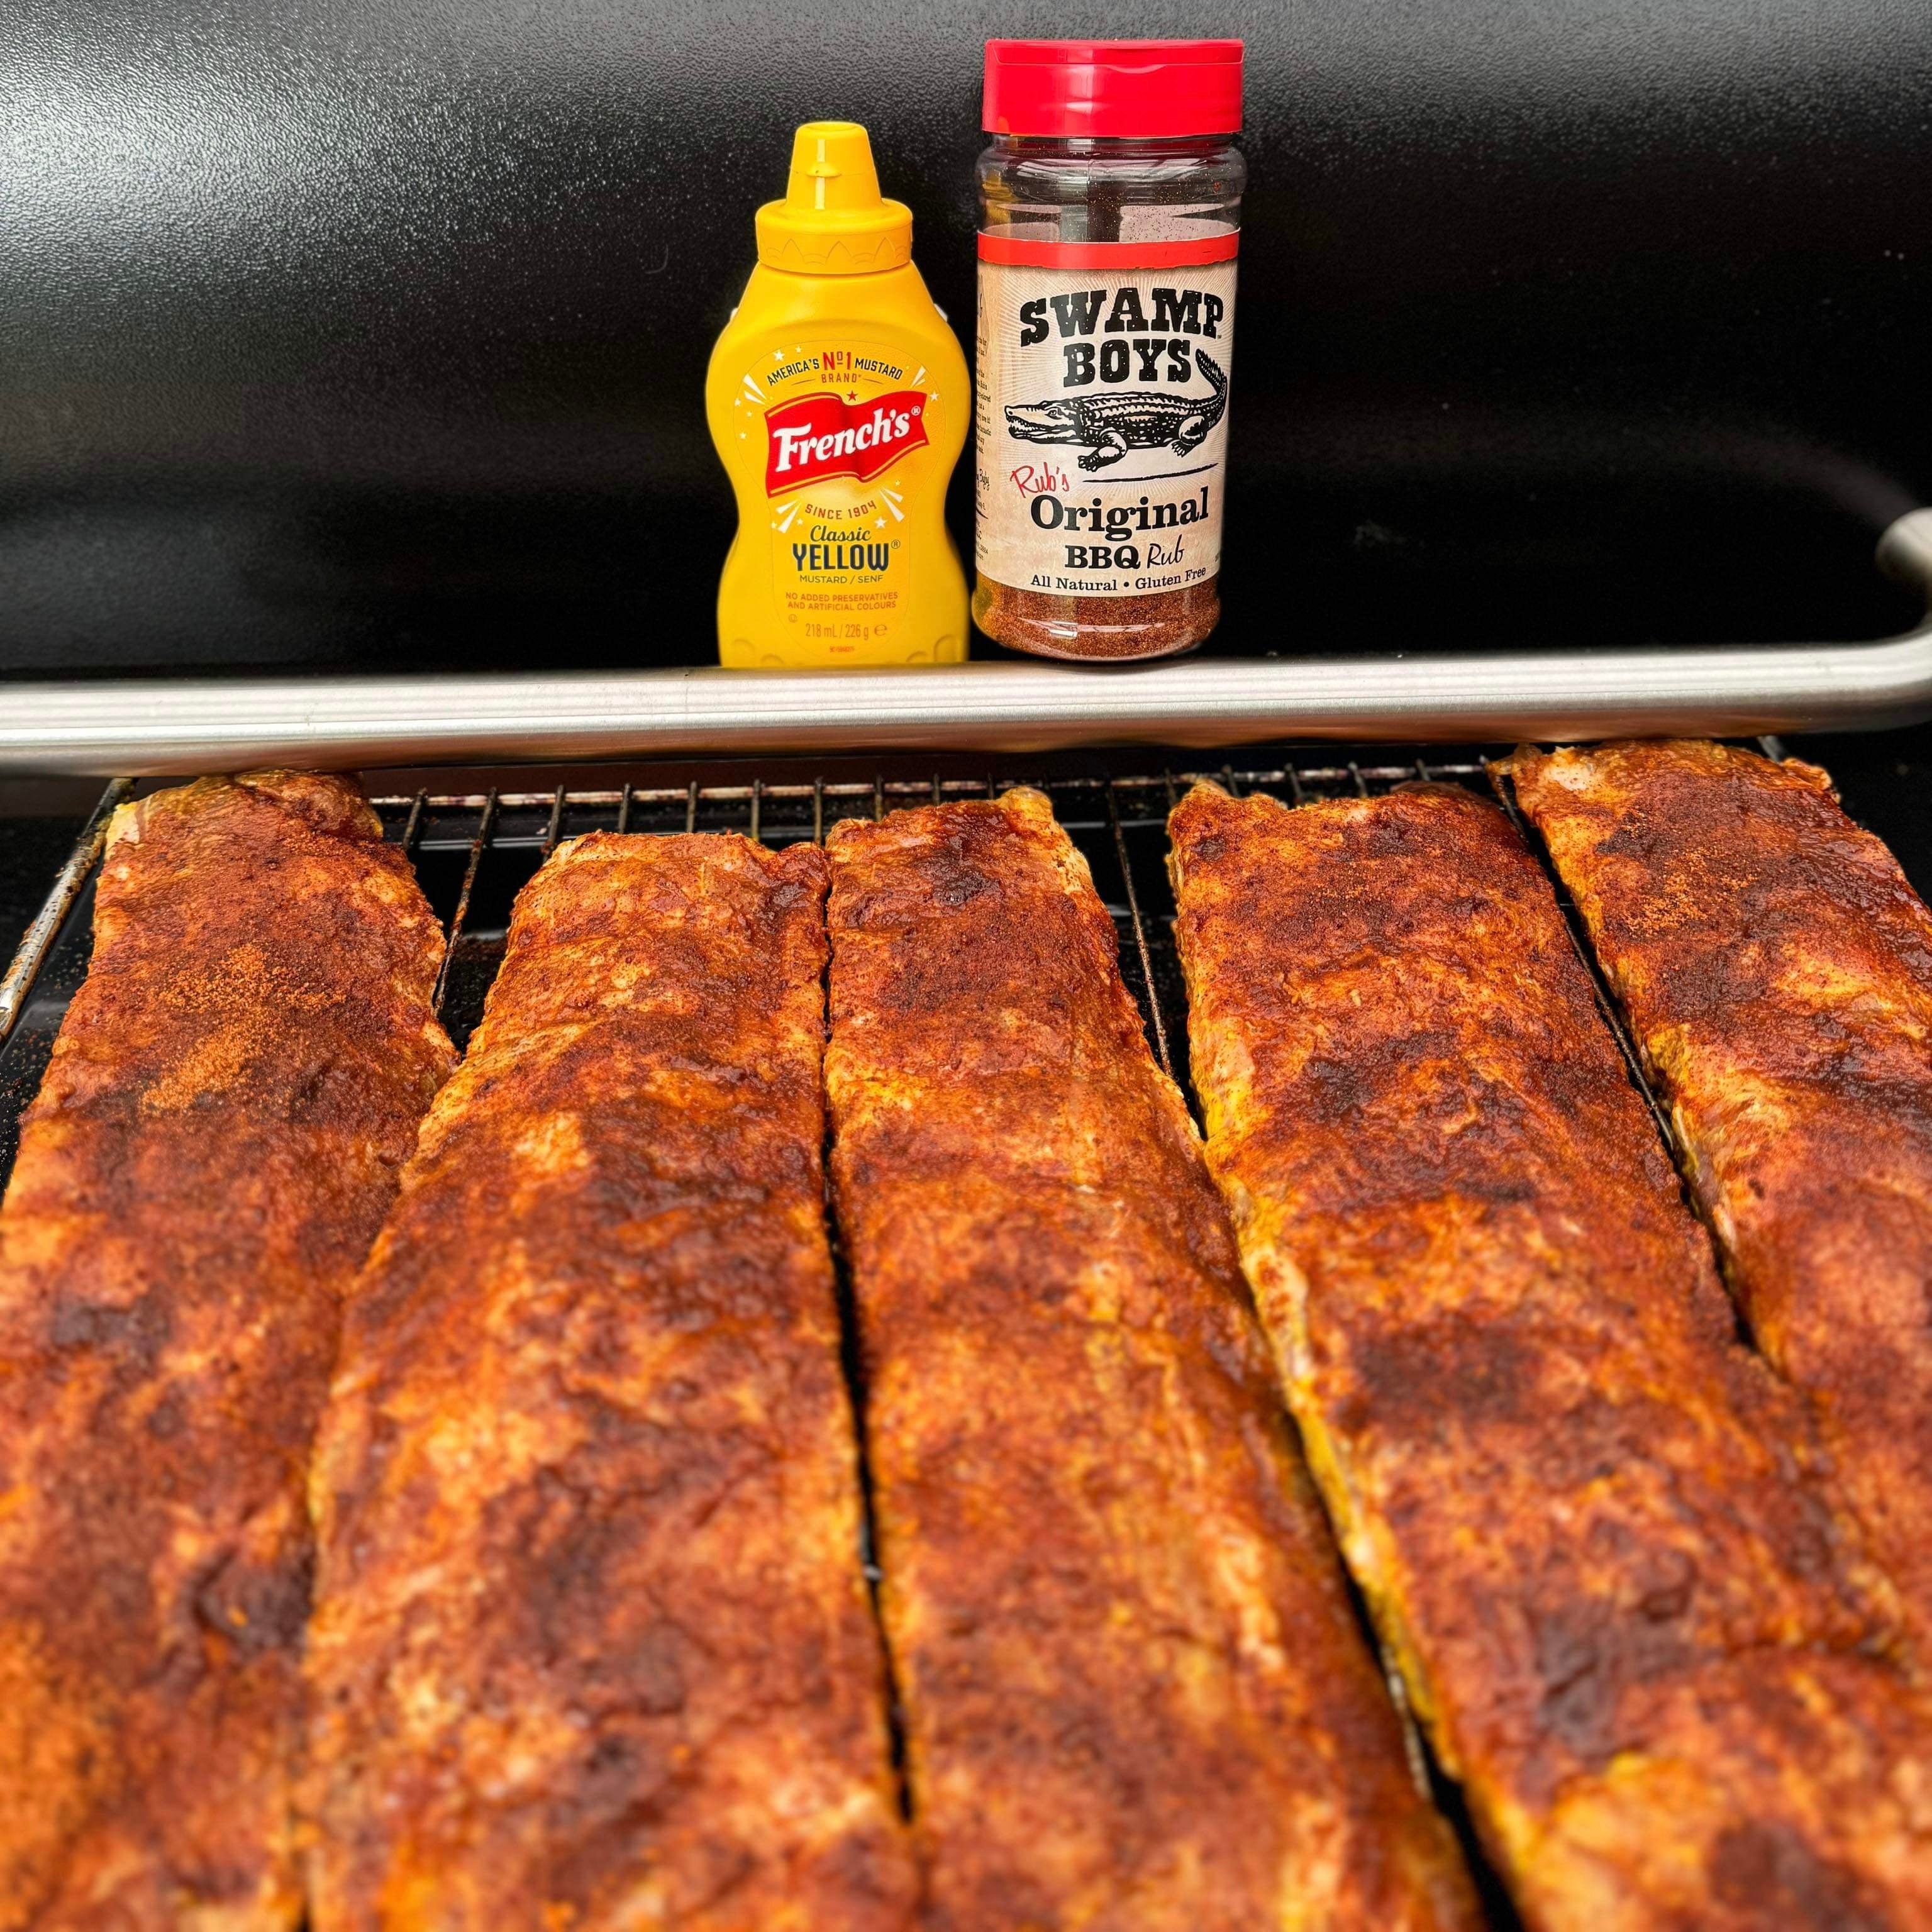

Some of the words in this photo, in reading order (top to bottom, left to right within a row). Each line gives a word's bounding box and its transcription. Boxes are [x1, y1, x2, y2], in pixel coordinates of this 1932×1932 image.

[1020, 287, 1224, 347] SWAMP
[767, 358, 819, 386] AMERICA'S
[855, 358, 903, 380] MUSTARD
[1063, 338, 1191, 387] BOYS
[1009, 462, 1069, 498] Rub's
[805, 504, 842, 520] SINCE
[848, 501, 877, 518] 1904
[1030, 486, 1209, 541] Original
[810, 525, 872, 542] Classic
[792, 543, 890, 572] YELLOW
[1065, 545, 1141, 570] BBQ
[1146, 535, 1185, 569] Rub
[800, 575, 847, 584] MUSTARD
[858, 575, 883, 584] SENF
[1031, 574, 1051, 588] All
[1055, 576, 1117, 591] Natural
[1135, 575, 1182, 590] Gluten
[1185, 567, 1206, 582] Free
[786, 592, 798, 601] NO
[801, 593, 830, 602] ADDED
[833, 592, 898, 602] PRESERVATIVES
[788, 601, 805, 610] AND
[808, 602, 854, 611] ARTIFICIAL
[857, 601, 896, 611] COLOURS
[806, 623, 821, 637] 218
[824, 624, 838, 637] mL
[845, 624, 861, 637] 226
[863, 626, 869, 640] g
